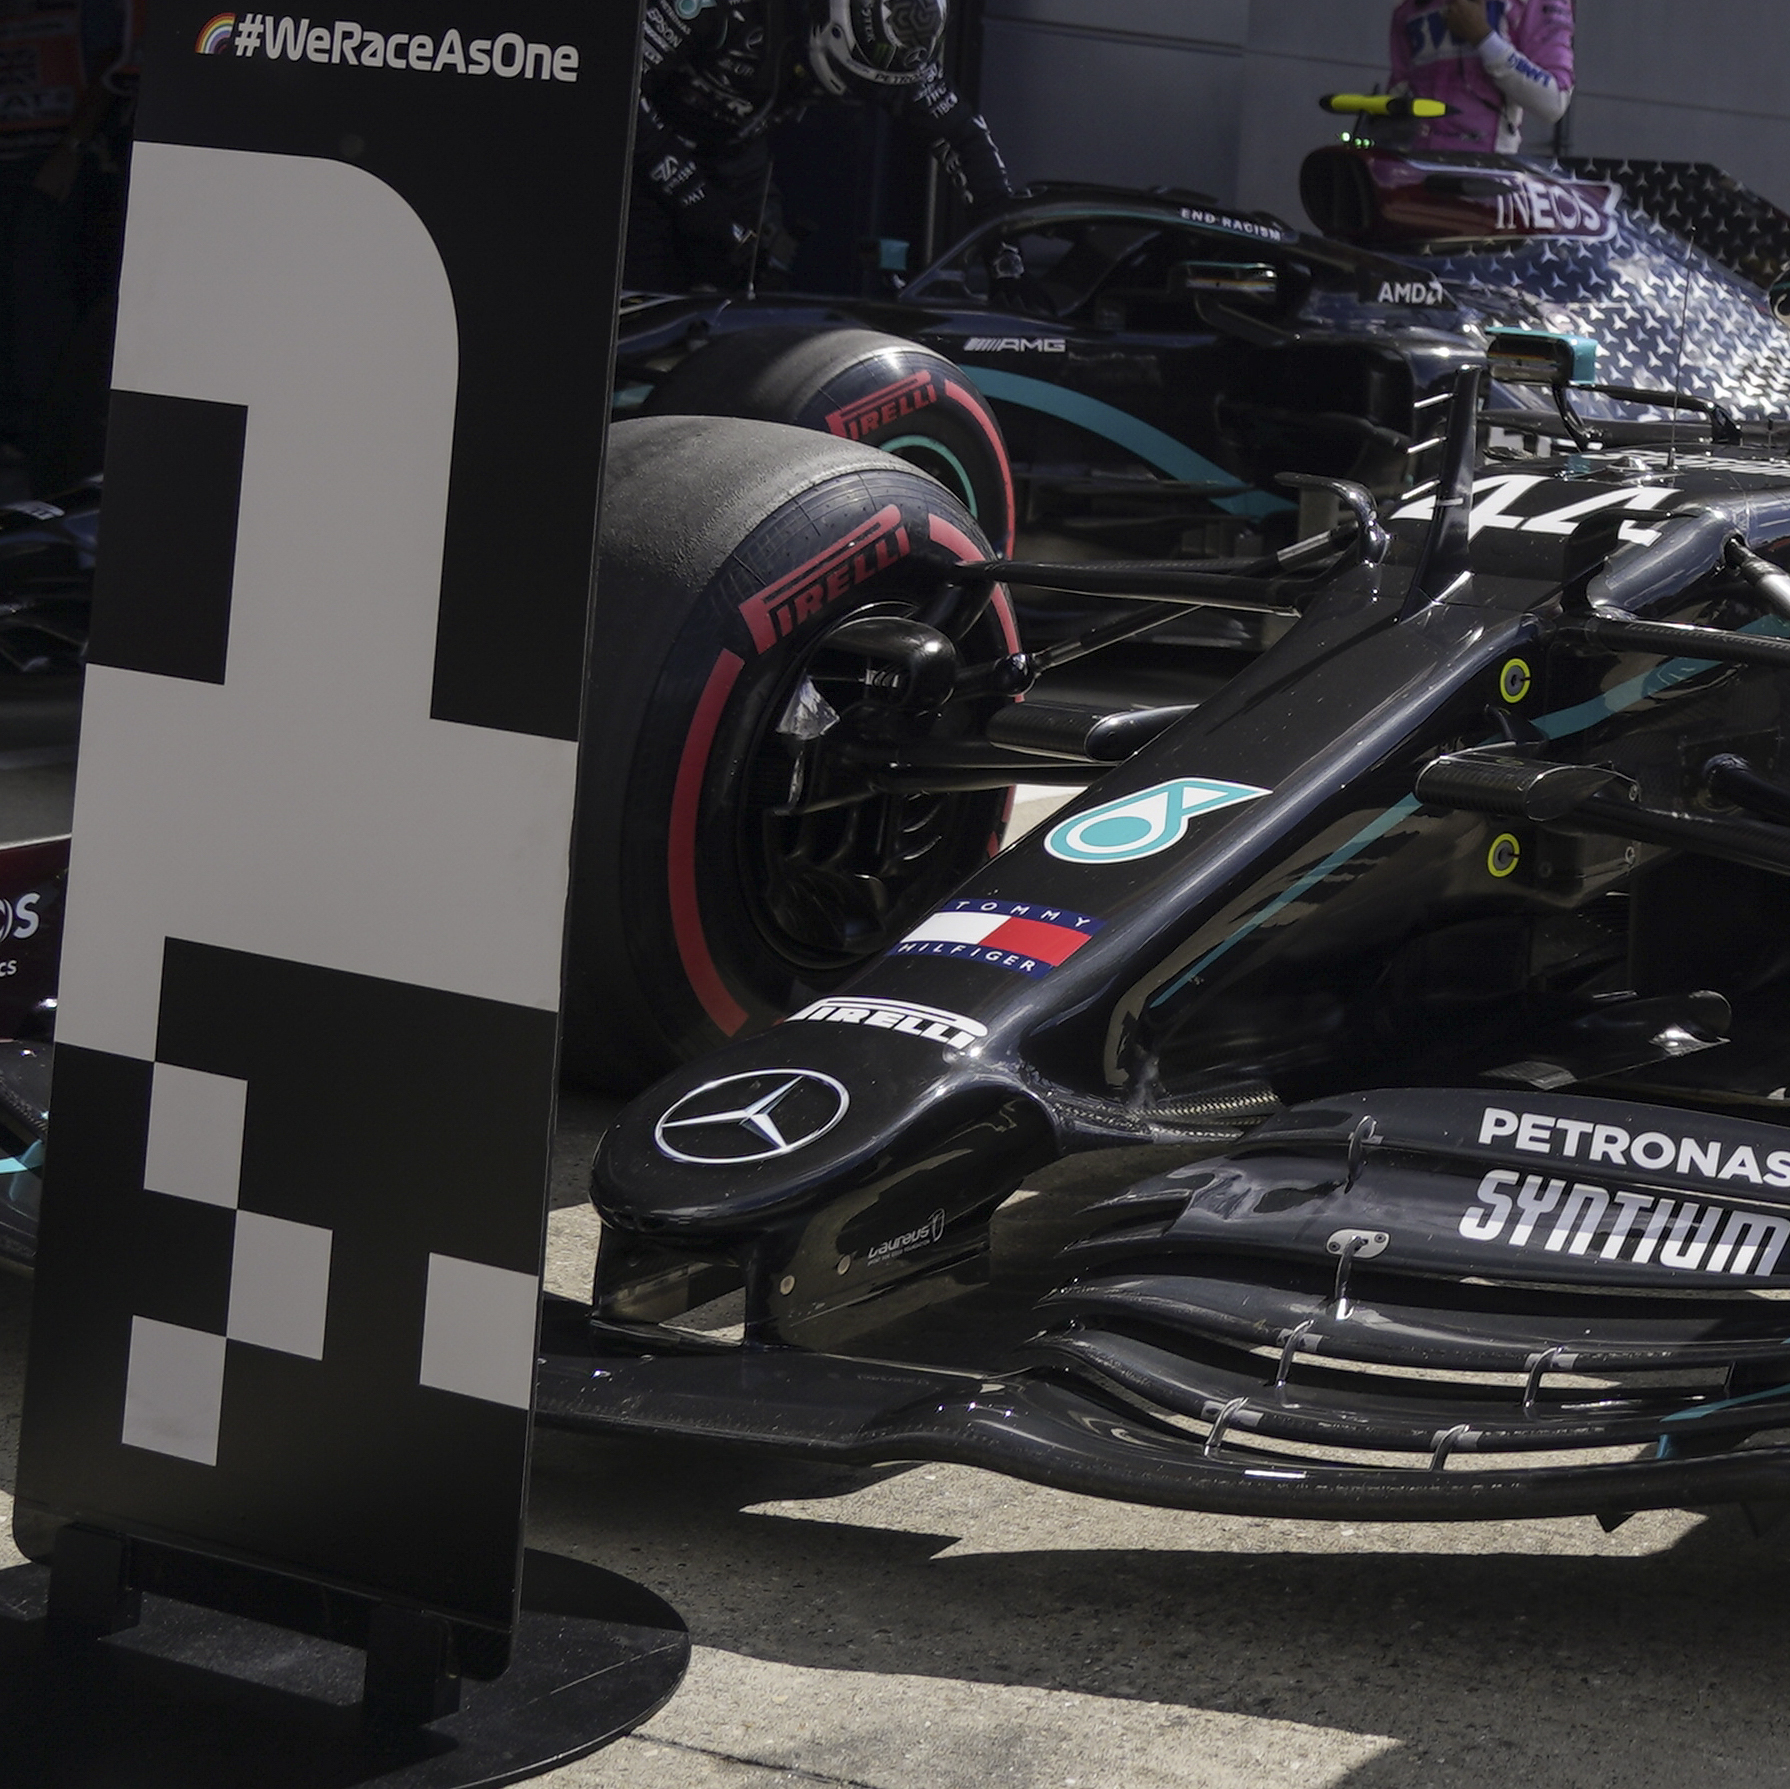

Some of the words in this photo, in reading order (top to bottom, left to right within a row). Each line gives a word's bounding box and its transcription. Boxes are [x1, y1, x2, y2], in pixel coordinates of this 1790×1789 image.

[234, 13, 580, 82] #WeRaceAsOne
[1180, 207, 1214, 226] END
[1221, 216, 1282, 243] RACISM
[1496, 184, 1601, 232] INEOS
[1377, 280, 1428, 304] AMD
[825, 369, 937, 440] PIRELLI
[1388, 473, 1683, 548] 44
[55, 141, 578, 1062] 1
[739, 503, 910, 655] PIRELLI
[952, 898, 1092, 929] TOMMY
[896, 942, 1038, 974] HILFIGER
[786, 995, 989, 1051] PIRELLI
